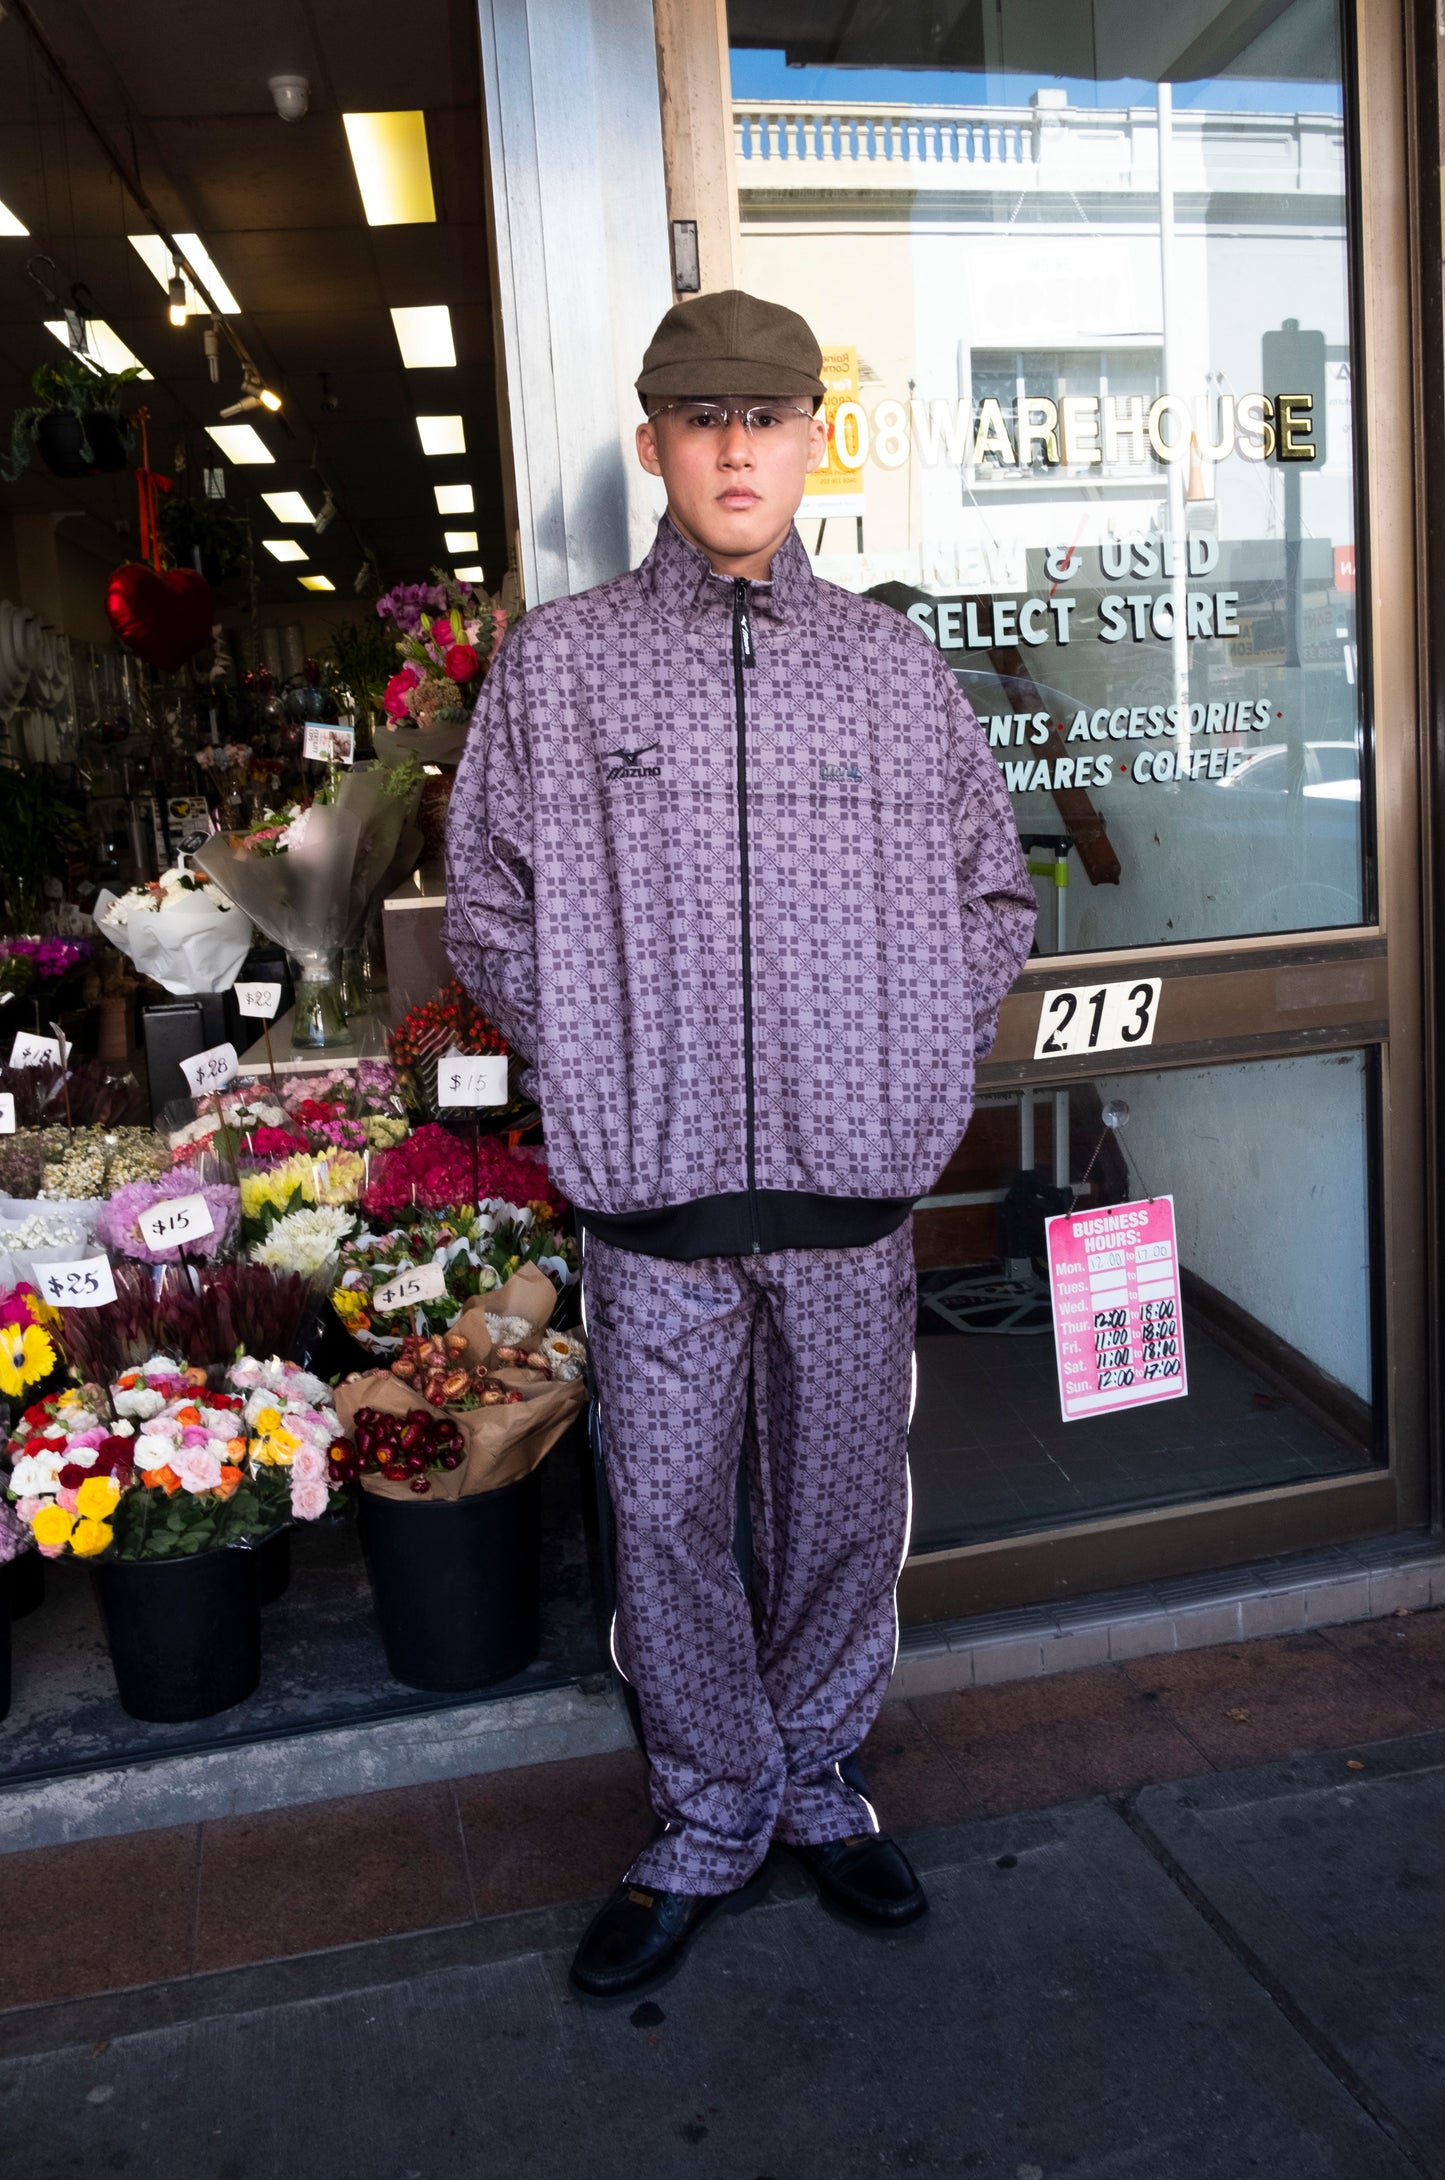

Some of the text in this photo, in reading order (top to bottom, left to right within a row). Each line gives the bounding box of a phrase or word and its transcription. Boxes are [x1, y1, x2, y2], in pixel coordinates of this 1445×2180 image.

[919, 530, 1219, 588] NEW & USED
[906, 592, 1239, 650] SELECT STORE
[1067, 699, 1272, 743] ACCESSORIES
[998, 747, 1243, 793] WARES COFFEE
[245, 991, 272, 1008] $22
[1042, 983, 1153, 1053] 213
[22, 1047, 52, 1064] $18
[196, 1057, 228, 1085] $28
[152, 1209, 190, 1235] $15
[1073, 1210, 1149, 1238] BUSINESS
[1085, 1231, 1141, 1253] HOURS:
[1056, 1262, 1086, 1276] Mon.
[1126, 1252, 1134, 1261] to
[48, 1270, 99, 1298] $25
[382, 1279, 421, 1303] $15
[1058, 1271, 1136, 1296] Tues. to
[1059, 1291, 1138, 1315] Wed. to
[1061, 1300, 1174, 1334] Thur. 12:00 to 18:00
[1062, 1321, 1176, 1355] Fri. 11:00 to 18:00
[1064, 1339, 1176, 1375] Sat. 11:00 to 18:00
[1066, 1359, 1181, 1394] Sun. 12:00 to 17:00
